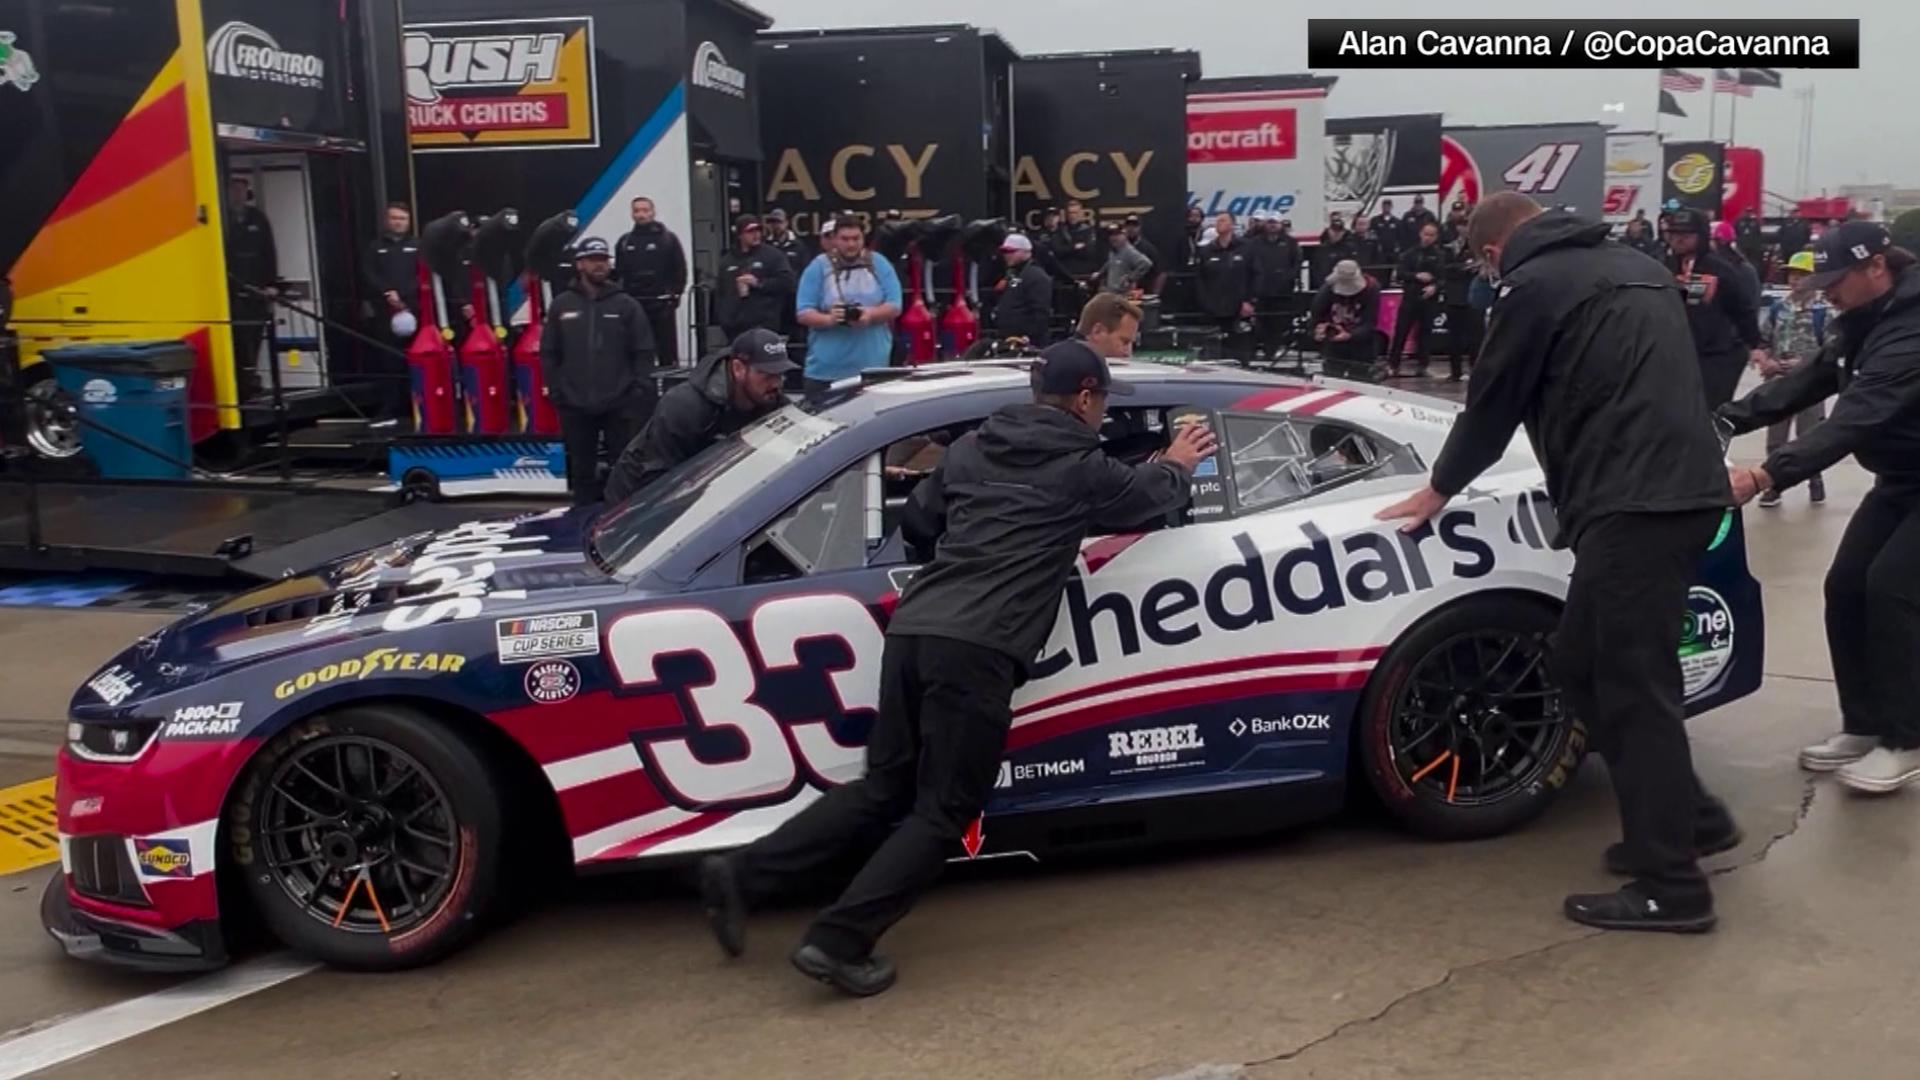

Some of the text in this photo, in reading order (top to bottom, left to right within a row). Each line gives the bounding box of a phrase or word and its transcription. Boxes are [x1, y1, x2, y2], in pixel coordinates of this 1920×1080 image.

[408, 101, 547, 126] RUCK CENTERS
[1187, 122, 1284, 149] orcraft
[766, 144, 939, 202] ACY
[1014, 150, 1154, 200] ACY
[1503, 143, 1582, 194] 41
[1602, 185, 1640, 215] 51
[530, 615, 582, 632] NASCAR
[512, 634, 585, 652] CUP SERIES
[274, 647, 467, 700] GOODYEAR
[607, 592, 885, 804] 33
[164, 718, 241, 737] PACK-RAT
[1108, 723, 1205, 758] REBEL
[1014, 758, 1085, 780] BETMGM
[140, 853, 189, 866] SUNOCO
